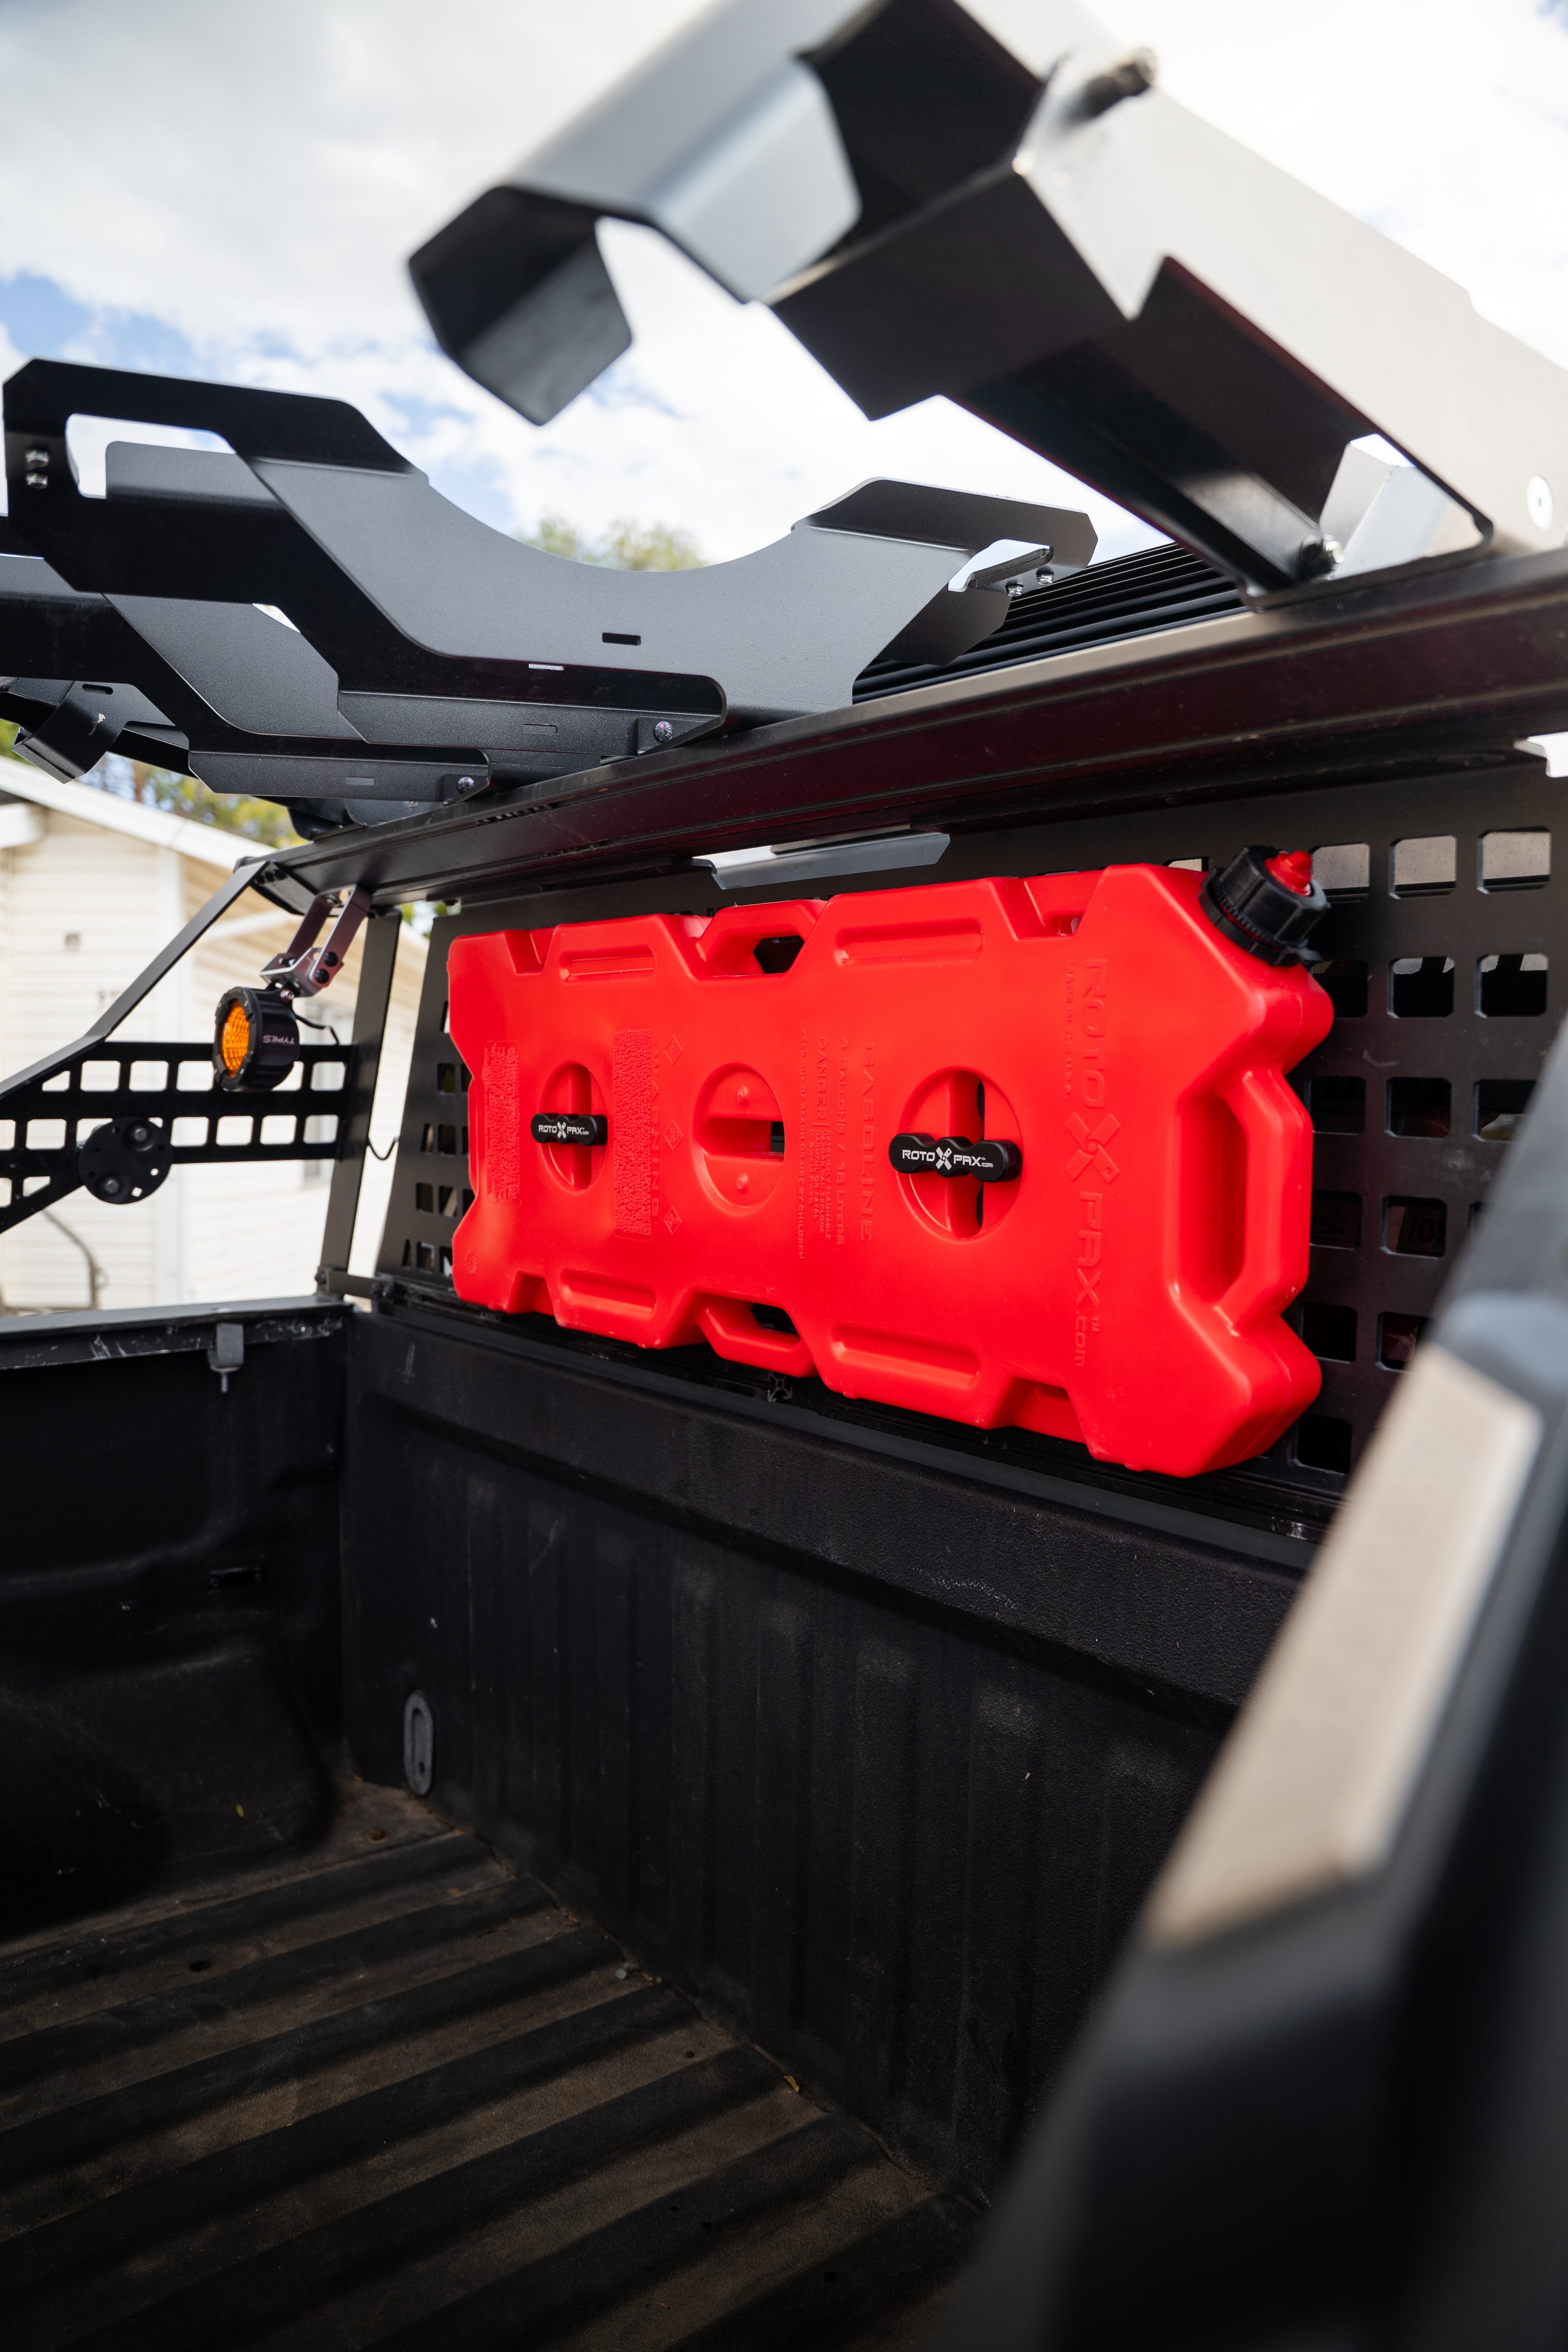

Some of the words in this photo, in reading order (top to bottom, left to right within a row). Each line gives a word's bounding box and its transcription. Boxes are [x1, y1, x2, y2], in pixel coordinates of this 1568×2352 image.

[800, 1085, 806, 1100] OF
[817, 1036, 828, 1120] DANGER
[838, 1057, 848, 1135] GALLONS
[651, 1050, 660, 1217] WARNING
[809, 1129, 815, 1139] IF
[860, 1042, 875, 1242] GASOLINE
[799, 1144, 805, 1159] OR
[799, 1188, 804, 1203] BY
[814, 1176, 819, 1189] OR
[836, 1189, 846, 1245] LITERS
